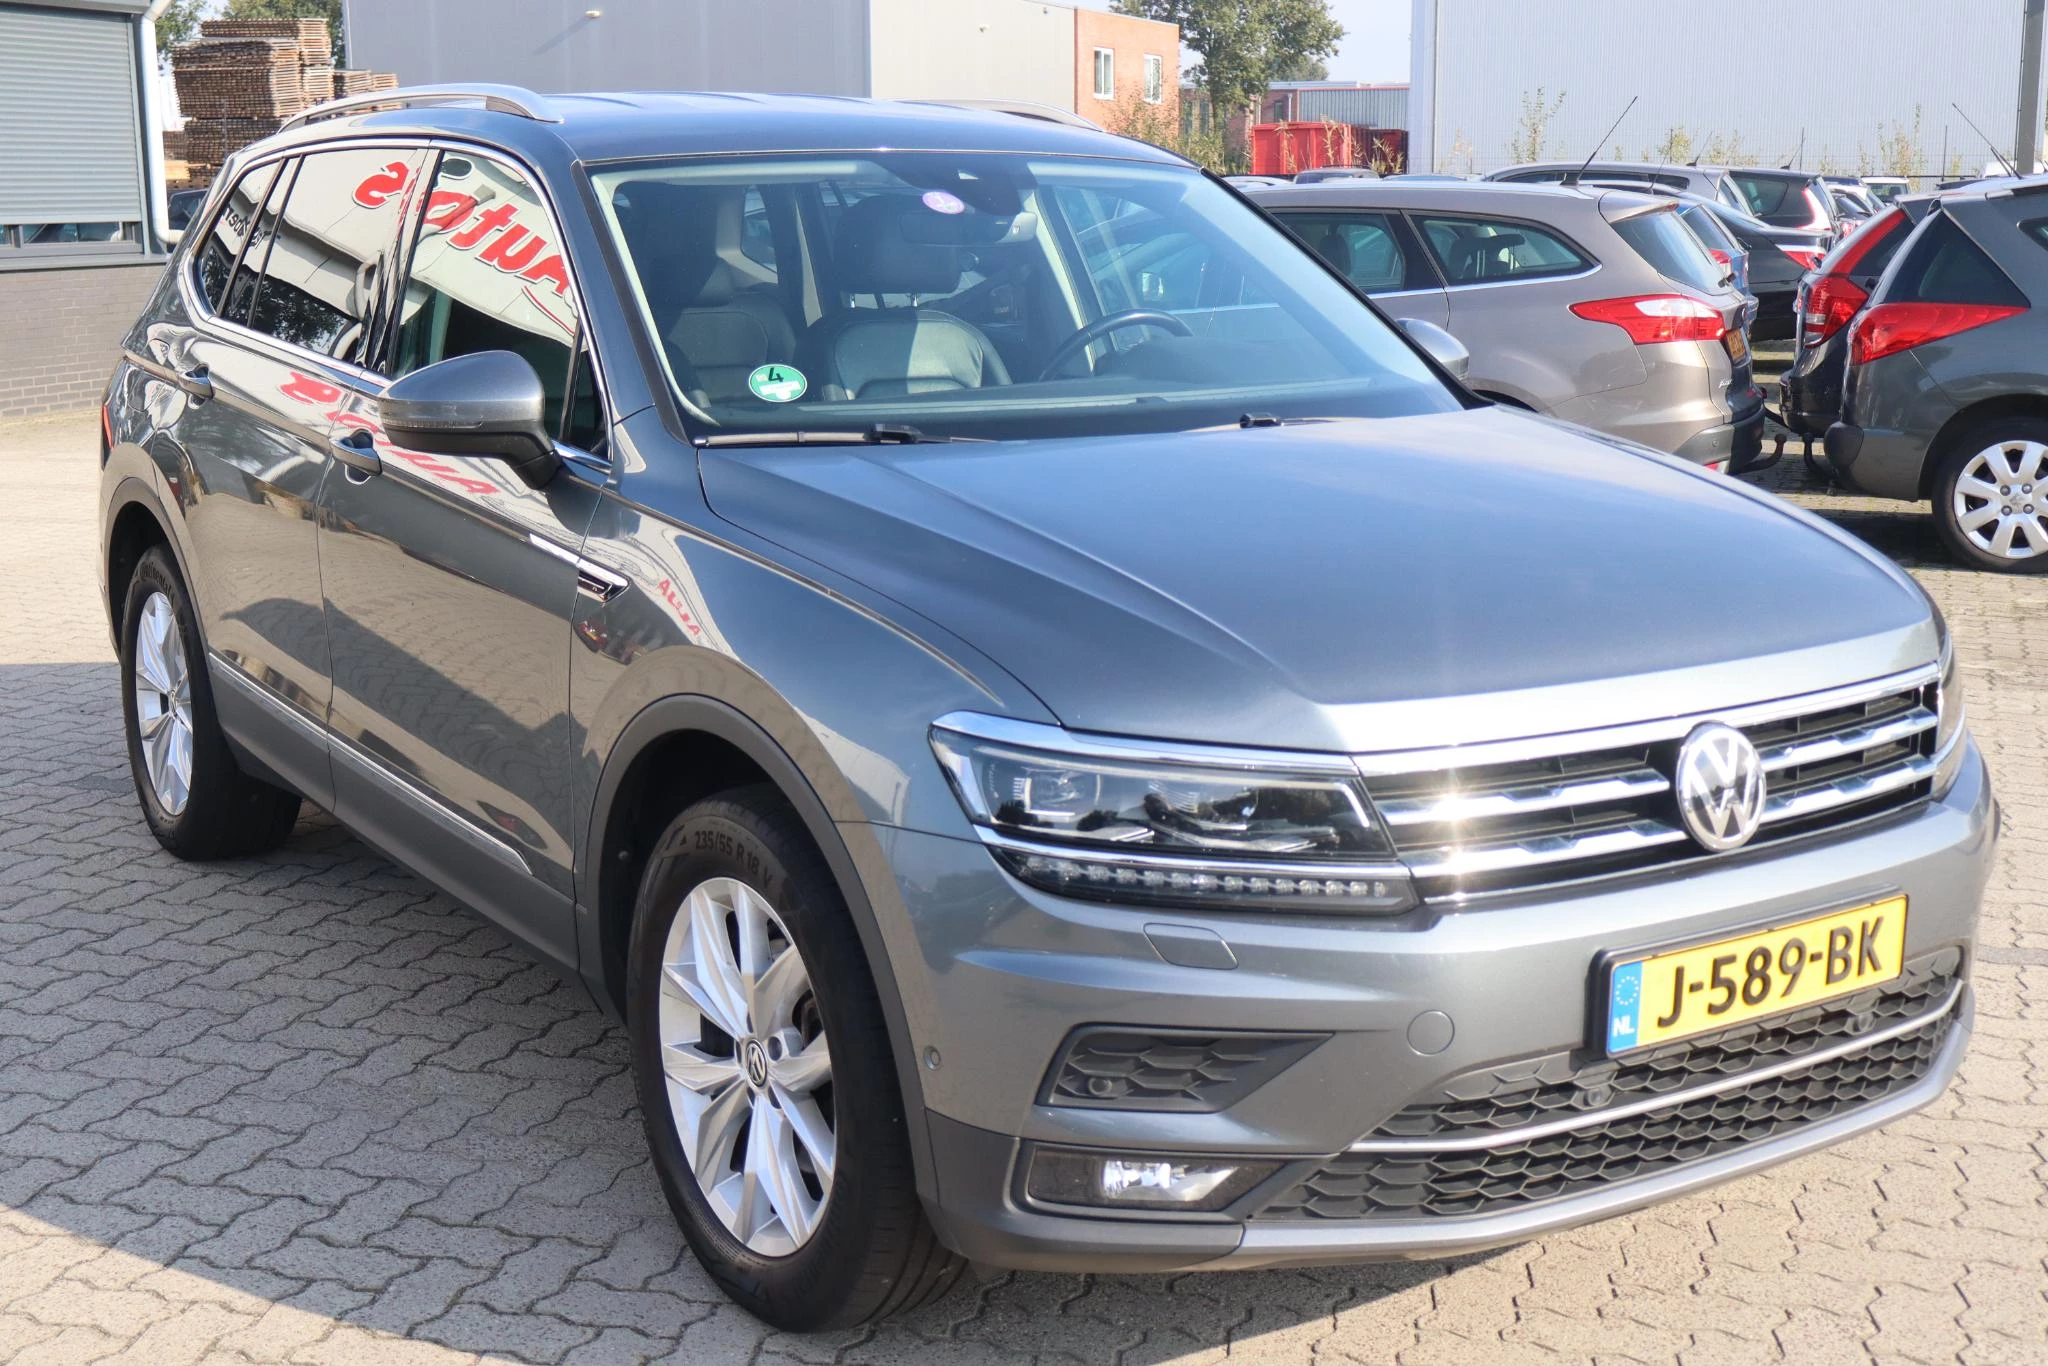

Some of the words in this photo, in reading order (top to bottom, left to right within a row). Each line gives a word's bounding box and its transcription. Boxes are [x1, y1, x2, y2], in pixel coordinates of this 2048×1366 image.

[768, 367, 784, 382] 4
[1657, 916, 1884, 1028] J-589-BK
[1613, 1015, 1635, 1037] NL
